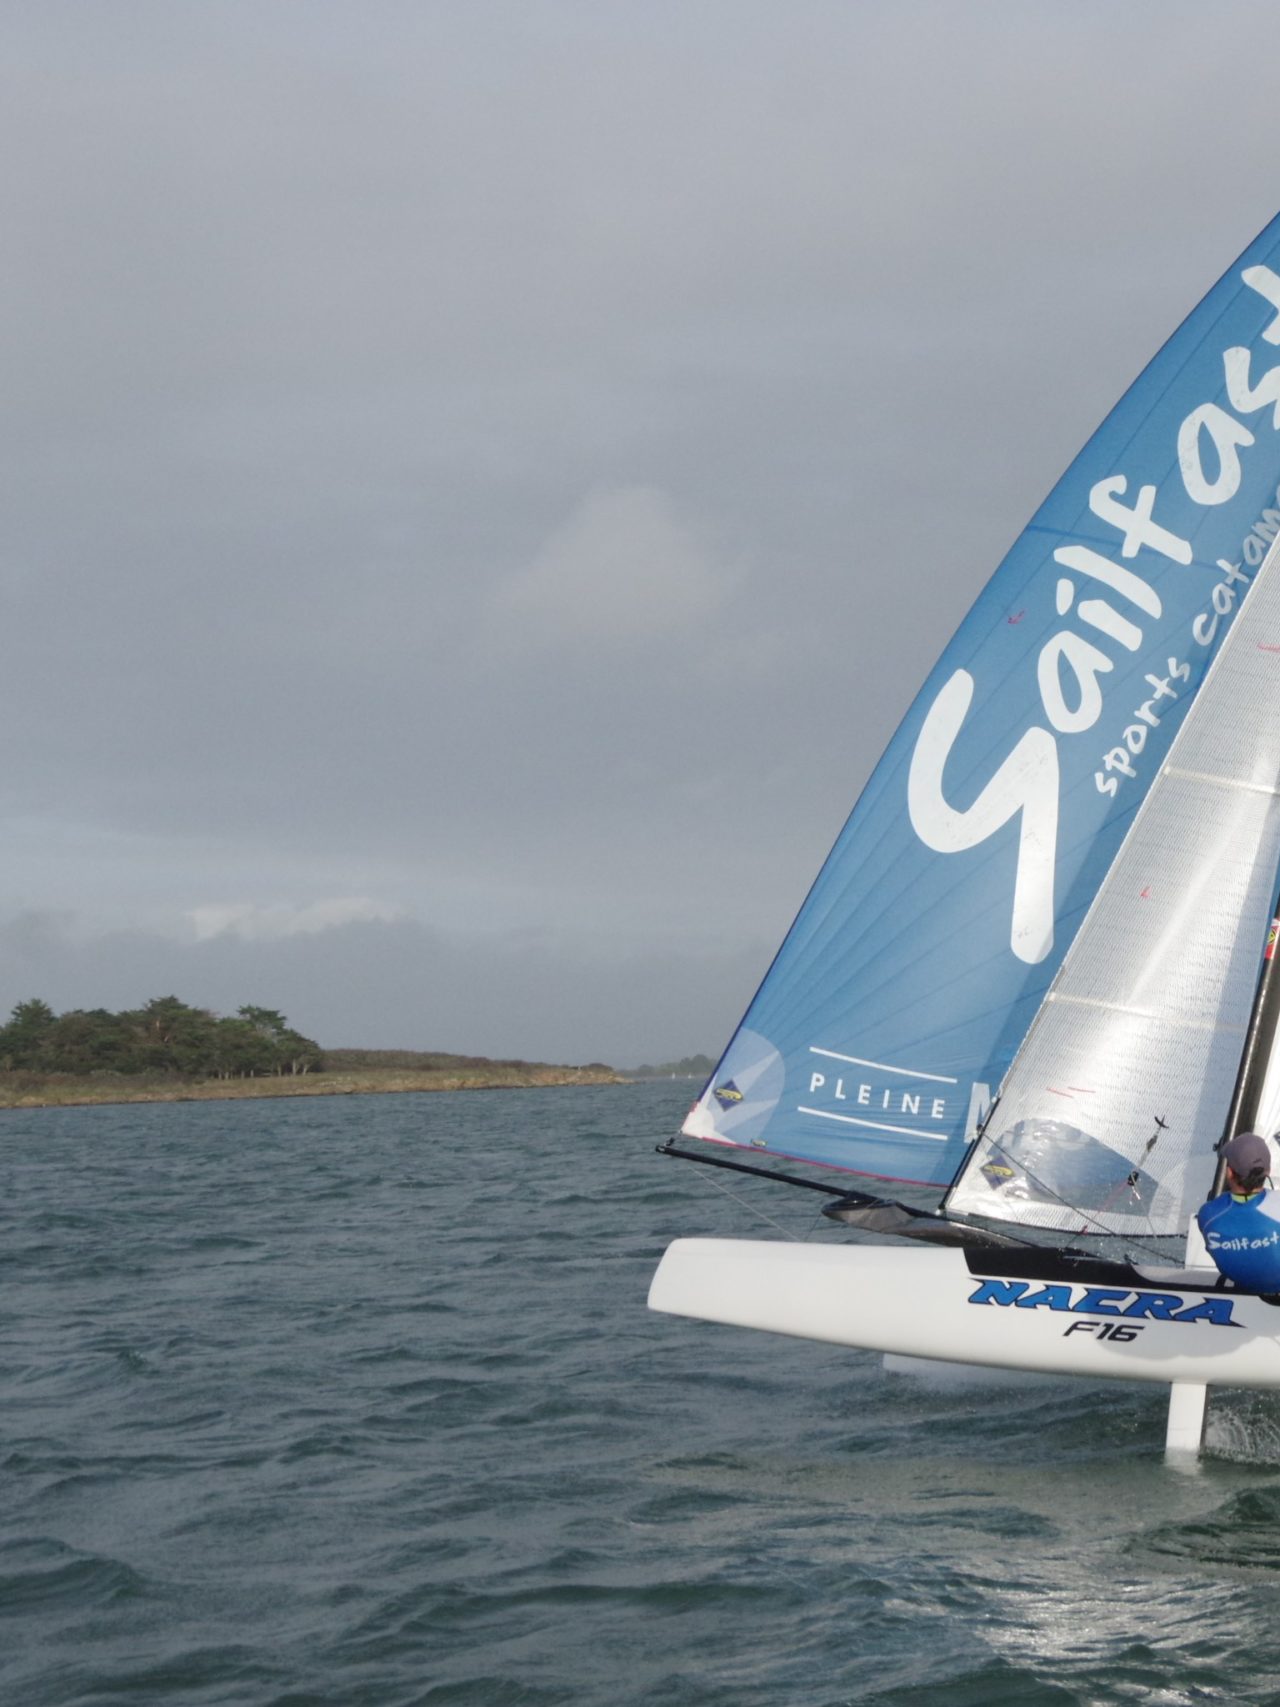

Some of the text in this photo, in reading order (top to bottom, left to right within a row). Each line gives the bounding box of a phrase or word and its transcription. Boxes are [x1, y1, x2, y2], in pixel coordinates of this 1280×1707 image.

[1095, 657, 1191, 798] sports
[809, 1072, 945, 1119] PLEINE
[1207, 1231, 1279, 1251] Sailfast
[967, 1278, 1247, 1328] NACRA
[1062, 1321, 1145, 1342] F16
